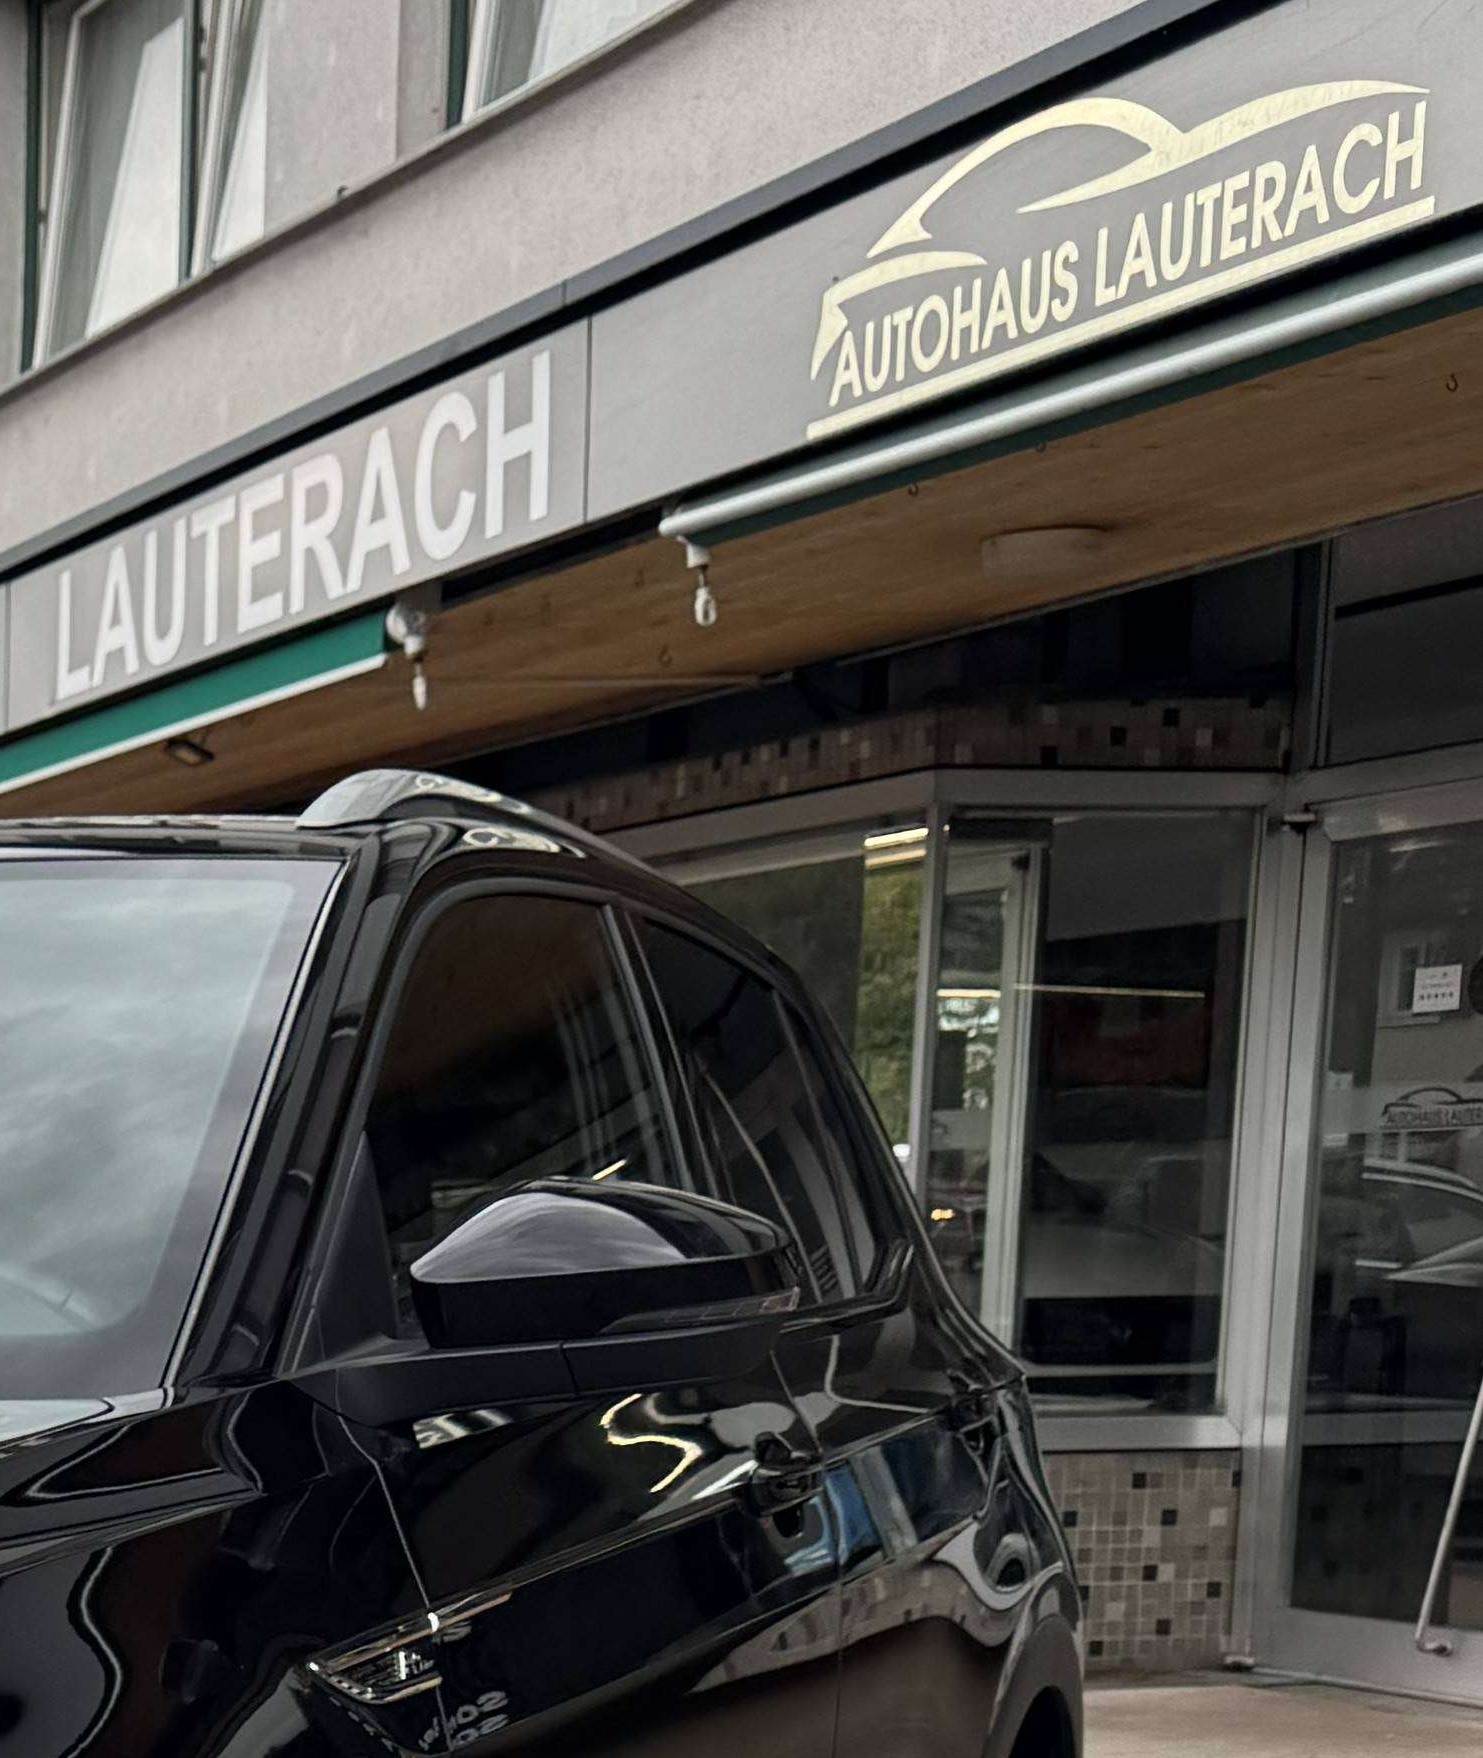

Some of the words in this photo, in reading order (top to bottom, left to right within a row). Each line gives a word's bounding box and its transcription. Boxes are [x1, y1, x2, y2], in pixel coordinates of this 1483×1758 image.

[829, 238, 1079, 408] AUTOHAUS
[1094, 100, 1427, 307] LAUTERACH
[55, 349, 551, 700] LAUTERACH
